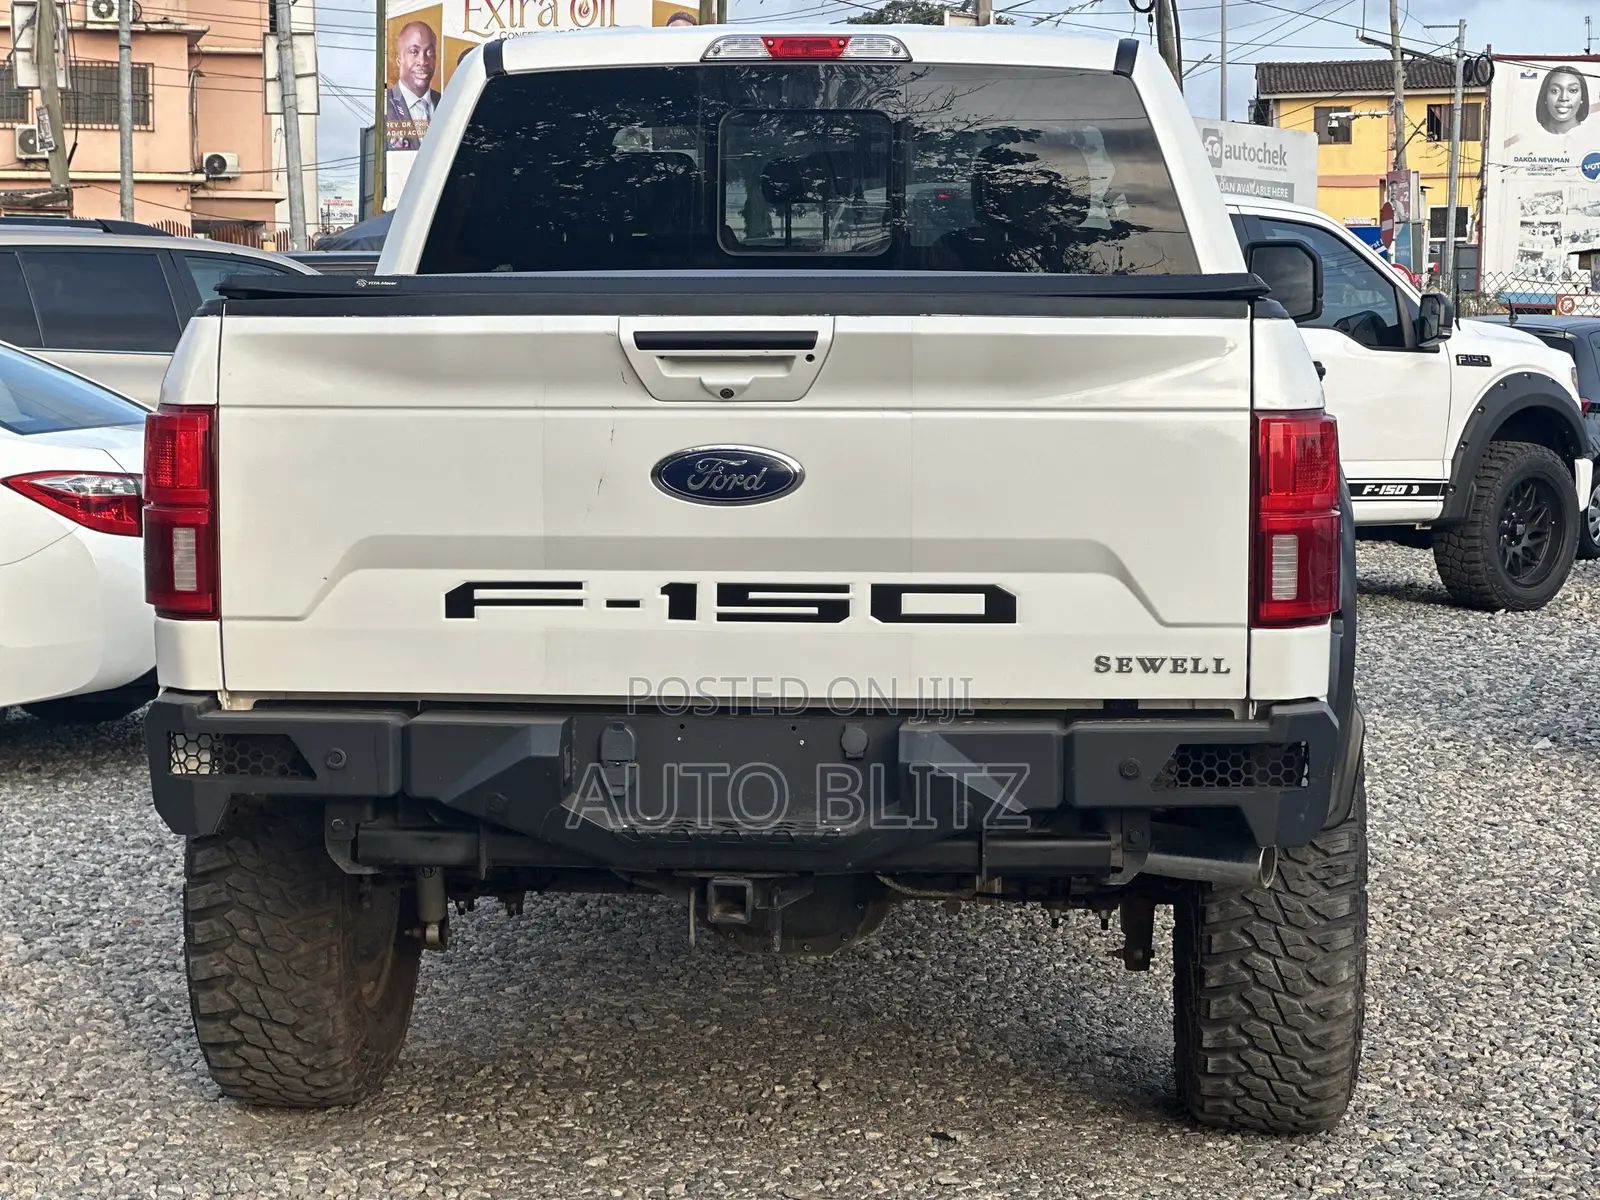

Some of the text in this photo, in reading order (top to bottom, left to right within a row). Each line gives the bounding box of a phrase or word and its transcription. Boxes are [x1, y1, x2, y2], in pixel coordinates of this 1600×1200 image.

[462, 0, 559, 38] Extra
[1224, 142, 1287, 167] autochek
[1220, 182, 1235, 192] OAN
[1272, 186, 1289, 198] HERE
[686, 457, 767, 491] Ford
[1361, 484, 1408, 495] F-150
[445, 581, 1017, 624] F-150
[1094, 655, 1231, 674] SEWELL
